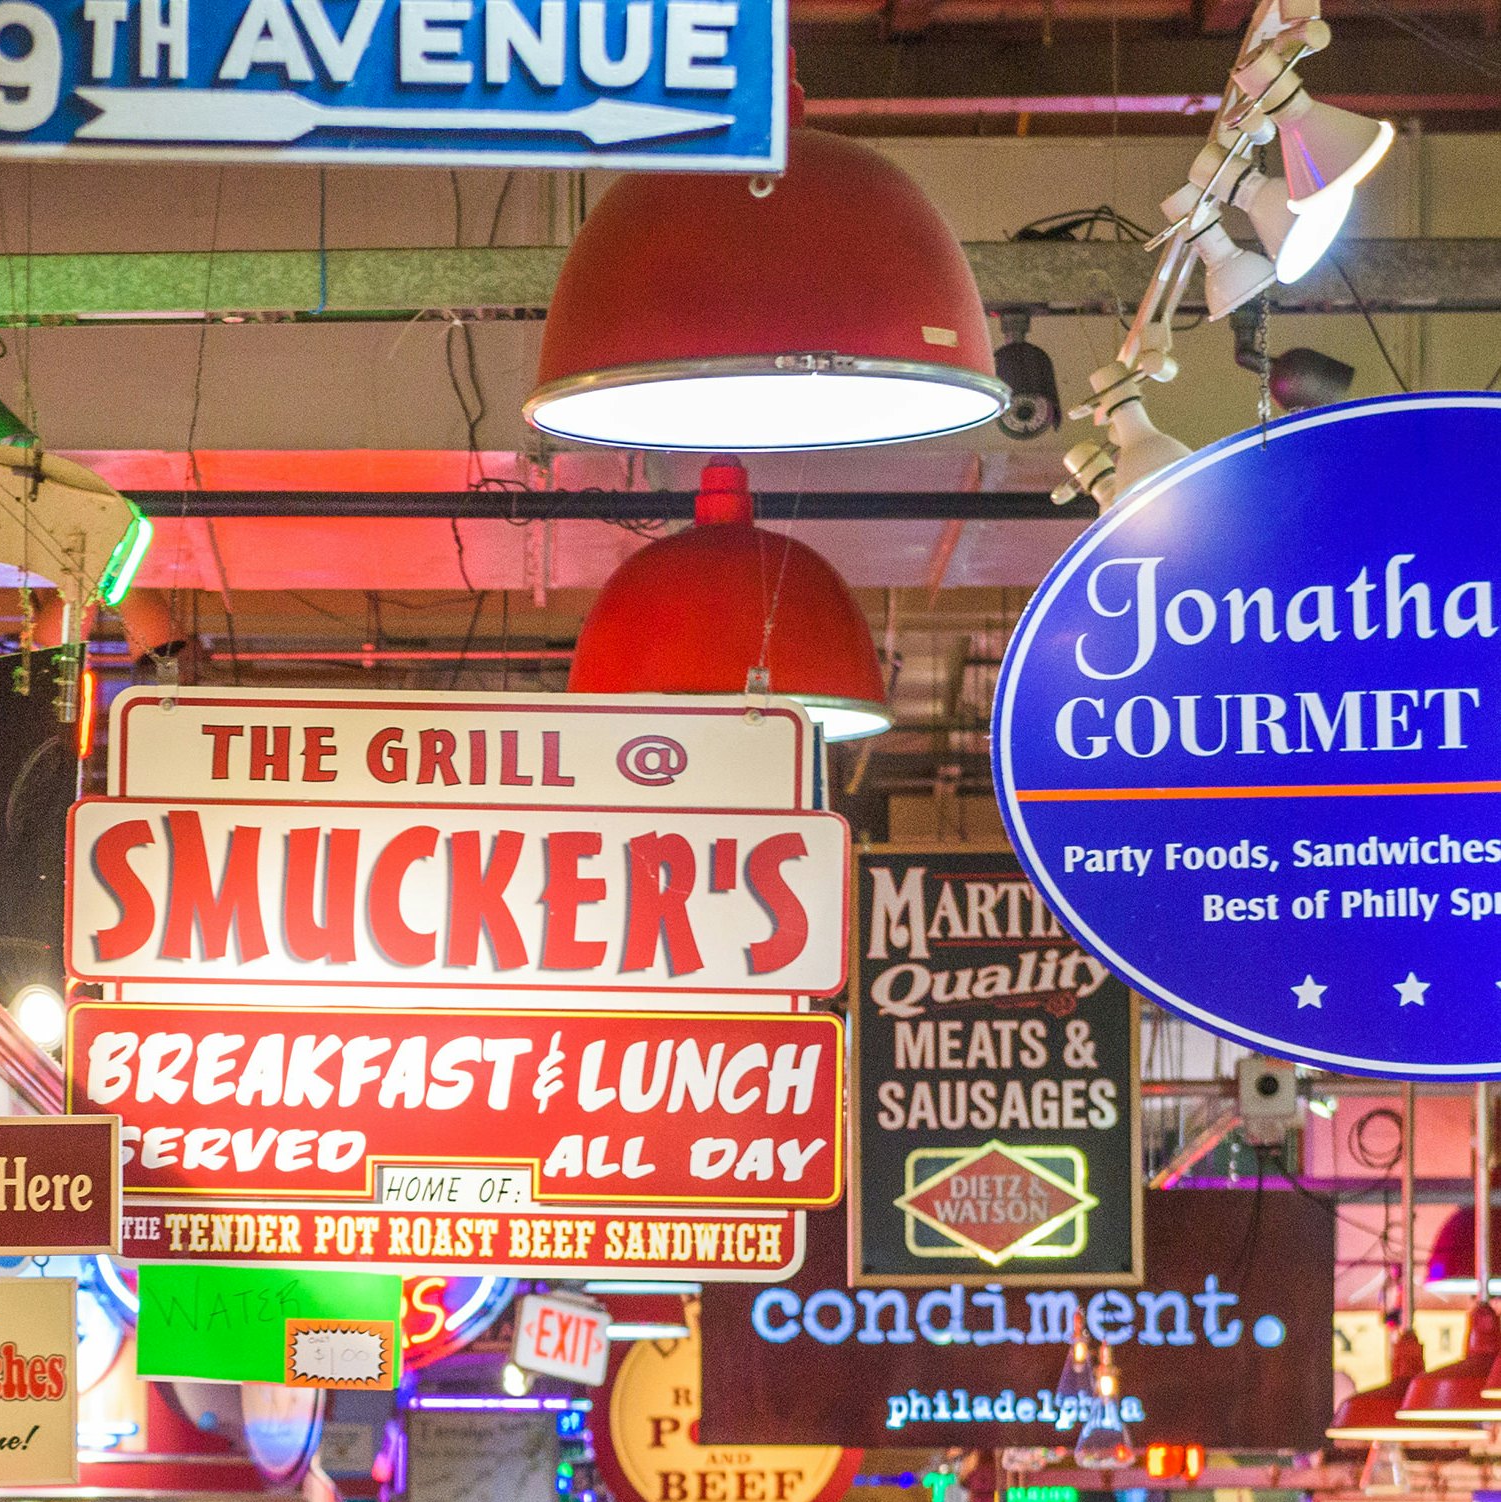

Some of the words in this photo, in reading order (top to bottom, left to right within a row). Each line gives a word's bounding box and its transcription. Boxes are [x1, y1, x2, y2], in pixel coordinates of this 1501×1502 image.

[218, 0, 738, 91] AVENUE
[1053, 687, 1481, 761] GOURMET
[200, 723, 339, 783] THE
[365, 725, 576, 788] GRILL
[615, 734, 689, 788] @
[1062, 845, 1154, 878] Party
[1164, 841, 1281, 873] Foods,
[92, 808, 810, 978] SMUCKER'S
[1202, 895, 1278, 922] Best
[1290, 893, 1332, 920] of
[1340, 886, 1441, 923] Philly
[869, 948, 1112, 1019] Quality
[894, 1019, 1049, 1071] MEATS
[1062, 1019, 1099, 1071] &
[86, 1031, 534, 1112] BREAKFAST
[577, 1042, 824, 1116] LUNCH
[876, 1078, 1120, 1131] SAUSAGES
[542, 1134, 656, 1180] ALL
[689, 1136, 828, 1183] DAY
[384, 1173, 462, 1205] HOME
[478, 1174, 524, 1205] OF:
[932, 1196, 1050, 1225] WATSON
[949, 1173, 1024, 1202] DIETZ
[122, 1216, 161, 1240] THE
[163, 1212, 302, 1256] TENDER
[313, 1215, 379, 1258] POT
[388, 1217, 497, 1260] ROAST
[507, 1219, 597, 1262] BEEF
[603, 1222, 784, 1265] SANDWICH
[147, 1279, 300, 1332] WATER
[536, 1307, 597, 1369] EXIT
[705, 1452, 752, 1466] AND
[657, 1470, 805, 1502] BEEF
